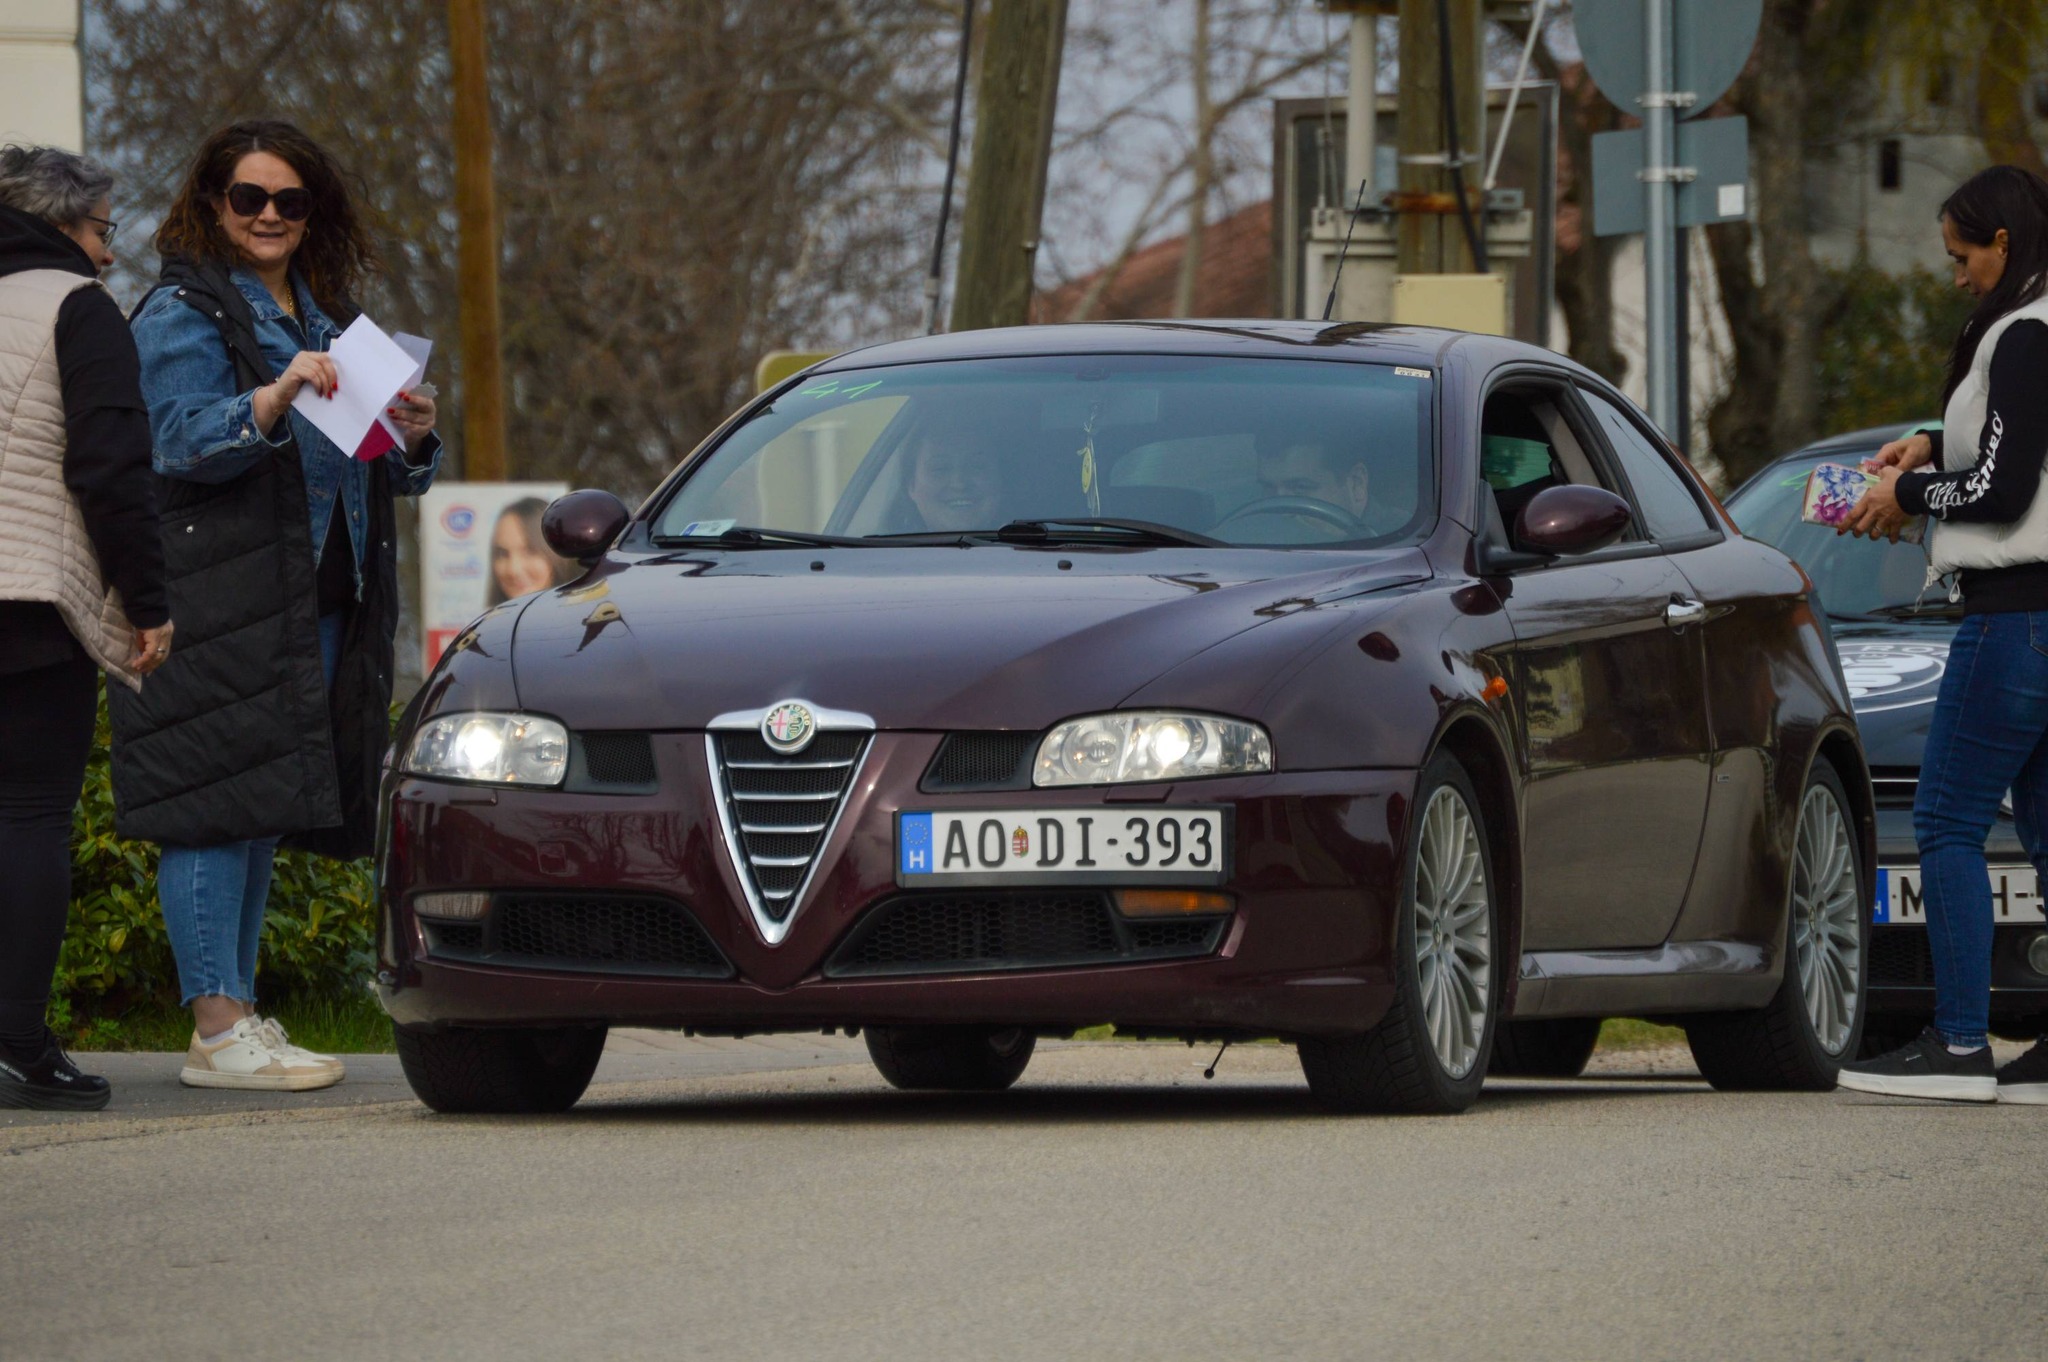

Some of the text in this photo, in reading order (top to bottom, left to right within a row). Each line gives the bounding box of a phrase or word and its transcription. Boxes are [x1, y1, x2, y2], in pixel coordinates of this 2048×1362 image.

[800, 380, 884, 399] 41
[942, 817, 1212, 868] AO DI-393
[909, 849, 924, 869] H
